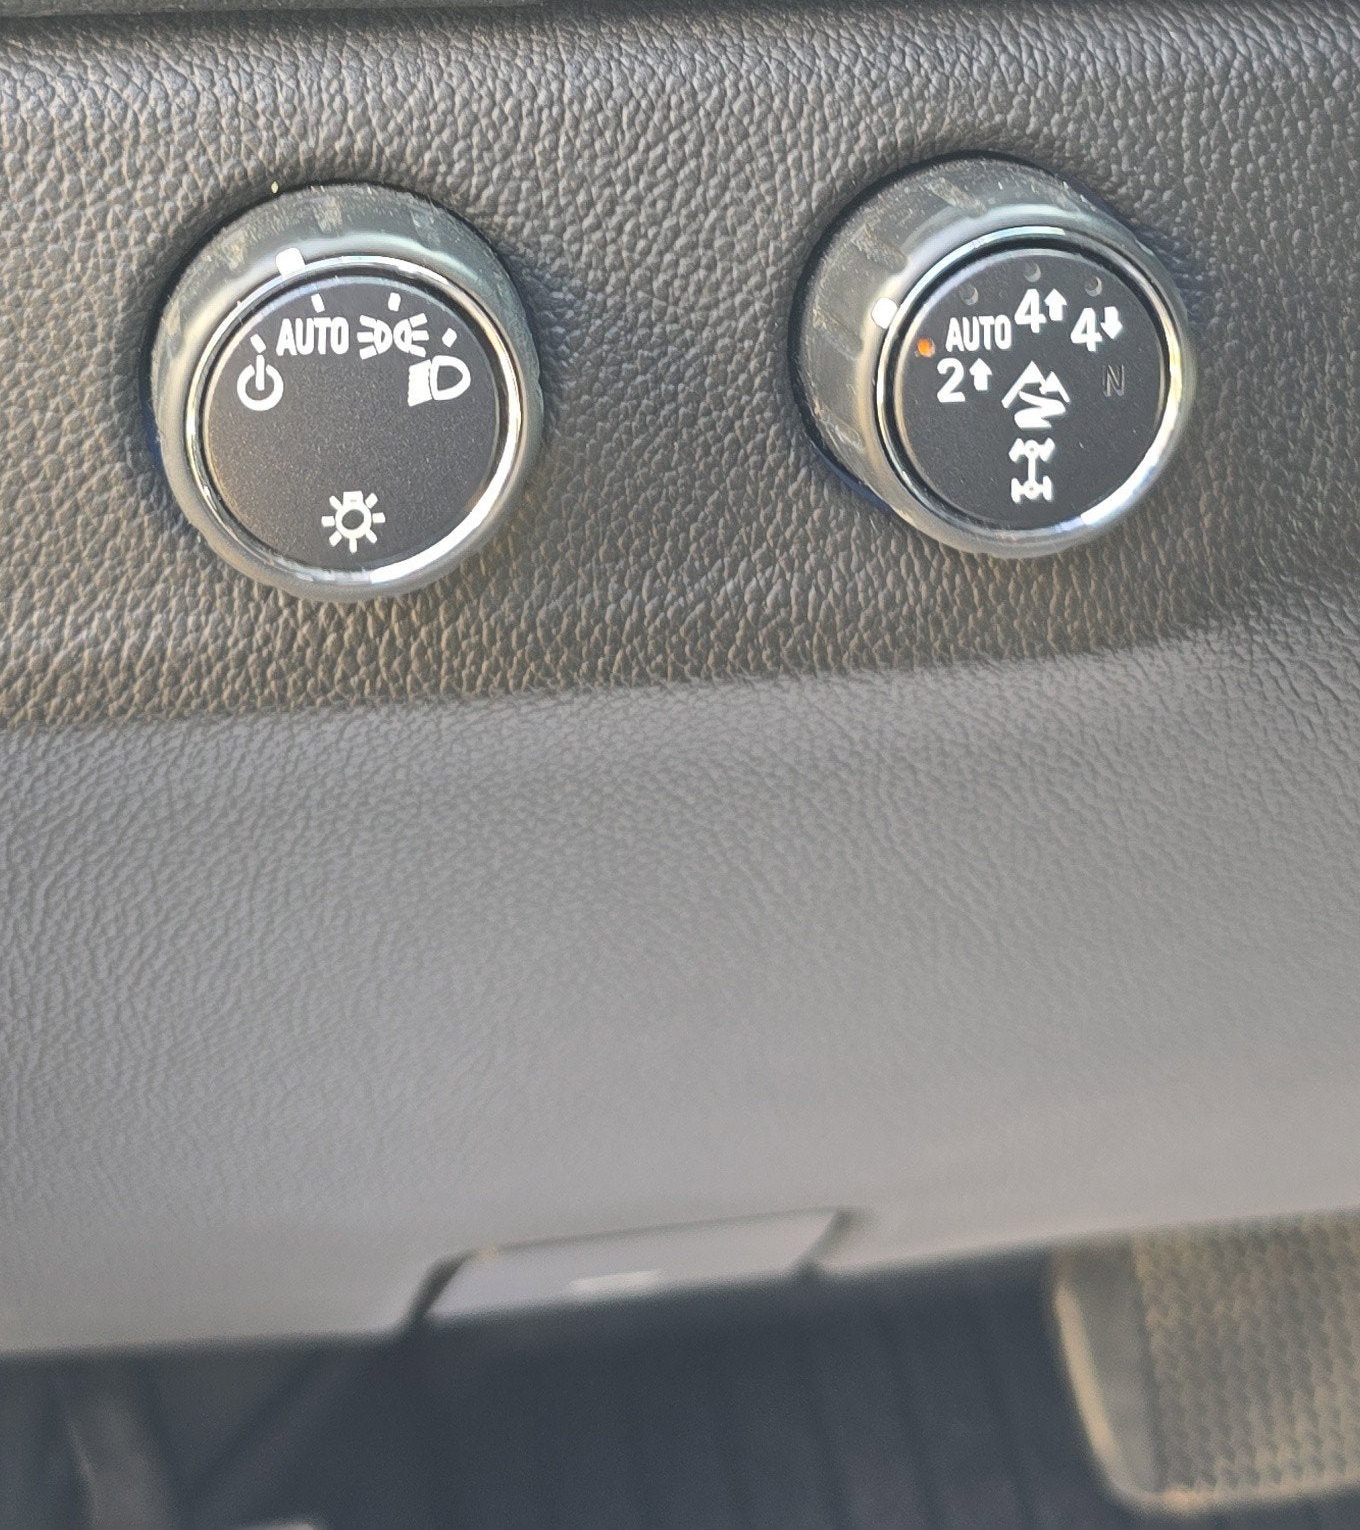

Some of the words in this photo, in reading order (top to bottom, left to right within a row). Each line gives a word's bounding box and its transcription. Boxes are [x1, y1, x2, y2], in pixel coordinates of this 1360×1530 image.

[275, 316, 350, 357] AUTO
[945, 314, 1013, 353] AUTO
[1101, 363, 1126, 398] N
